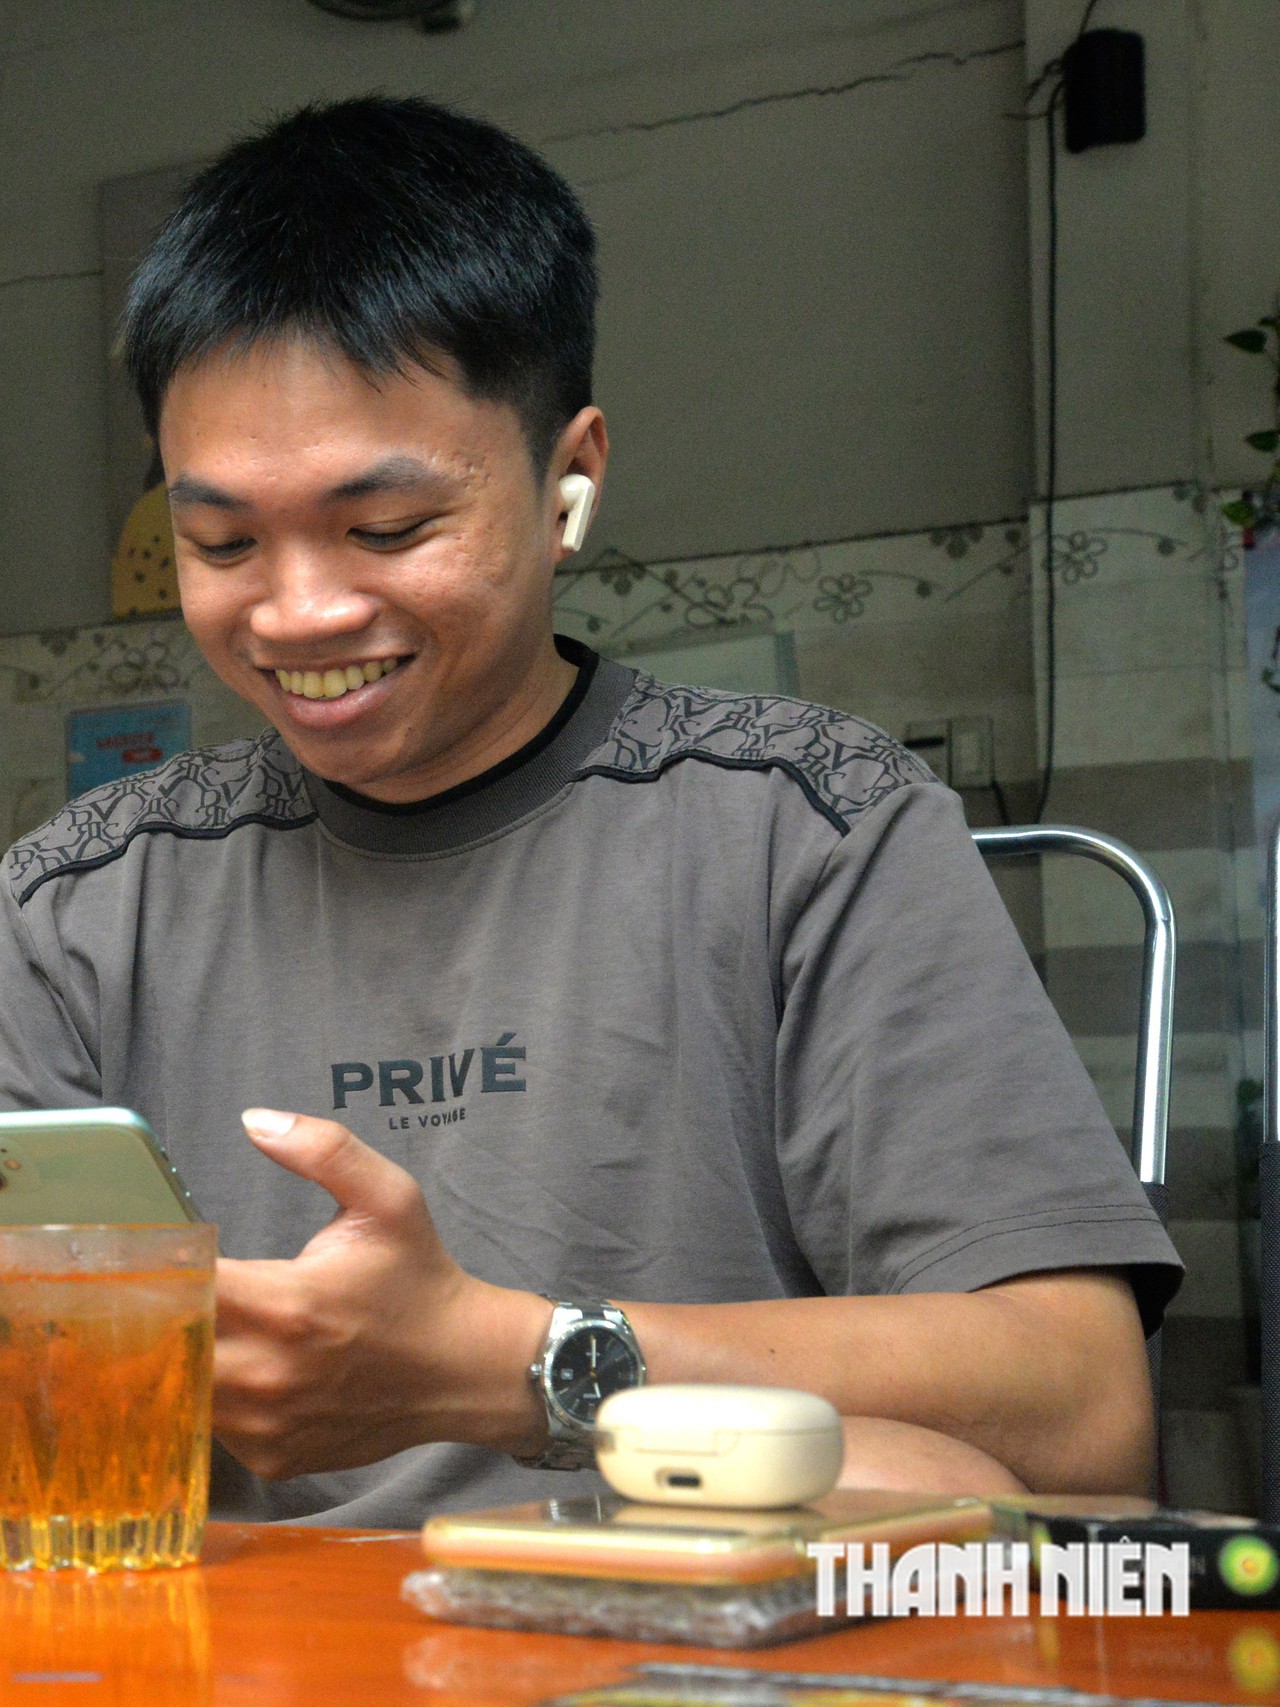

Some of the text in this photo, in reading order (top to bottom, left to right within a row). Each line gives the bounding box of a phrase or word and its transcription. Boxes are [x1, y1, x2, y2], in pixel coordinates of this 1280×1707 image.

[331, 1032, 526, 1109] PRIVÉ
[389, 1108, 467, 1130] LE VOYAGE
